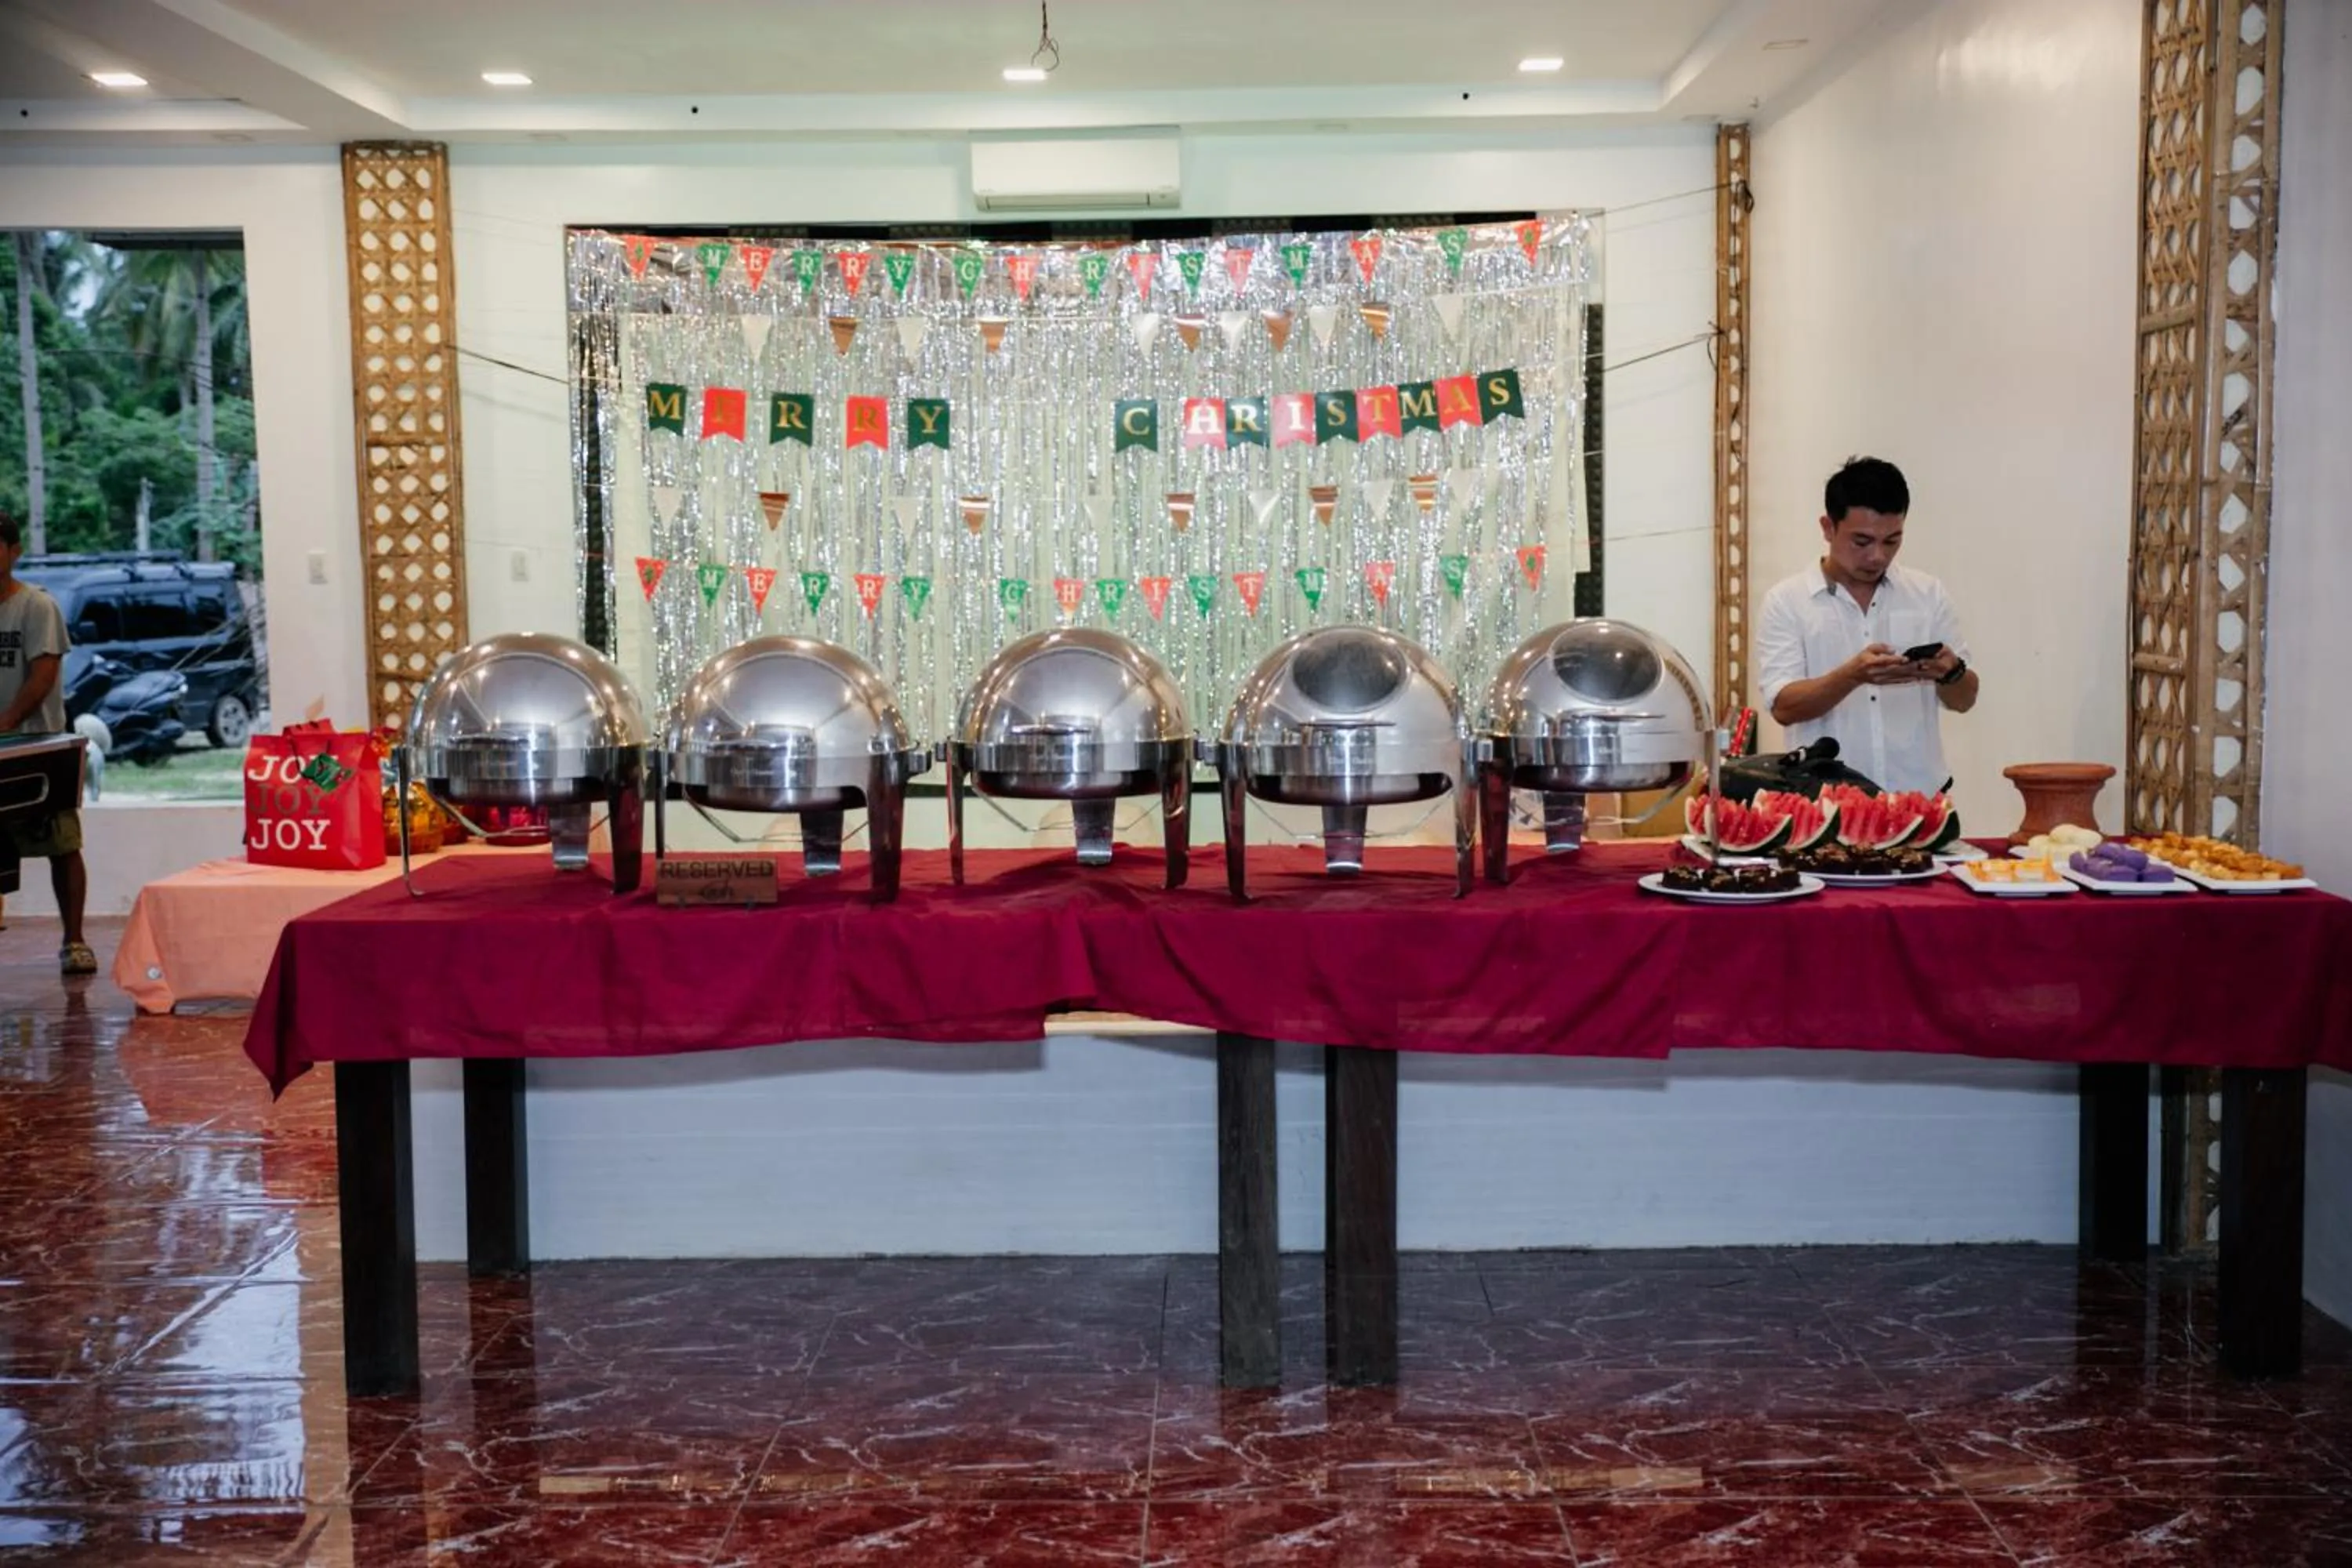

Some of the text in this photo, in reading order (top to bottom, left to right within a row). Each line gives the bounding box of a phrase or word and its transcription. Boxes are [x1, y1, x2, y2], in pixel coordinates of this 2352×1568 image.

[705, 233, 1463, 282] MERRY CHRISTMAS
[648, 377, 1510, 436] MERRY CHRISTMAS
[703, 562, 1463, 603] MERRY CHRISTMAS
[248, 754, 339, 784] JO
[249, 784, 325, 816] JOY
[251, 818, 332, 851] JOY
[660, 860, 774, 879] RESERVED
